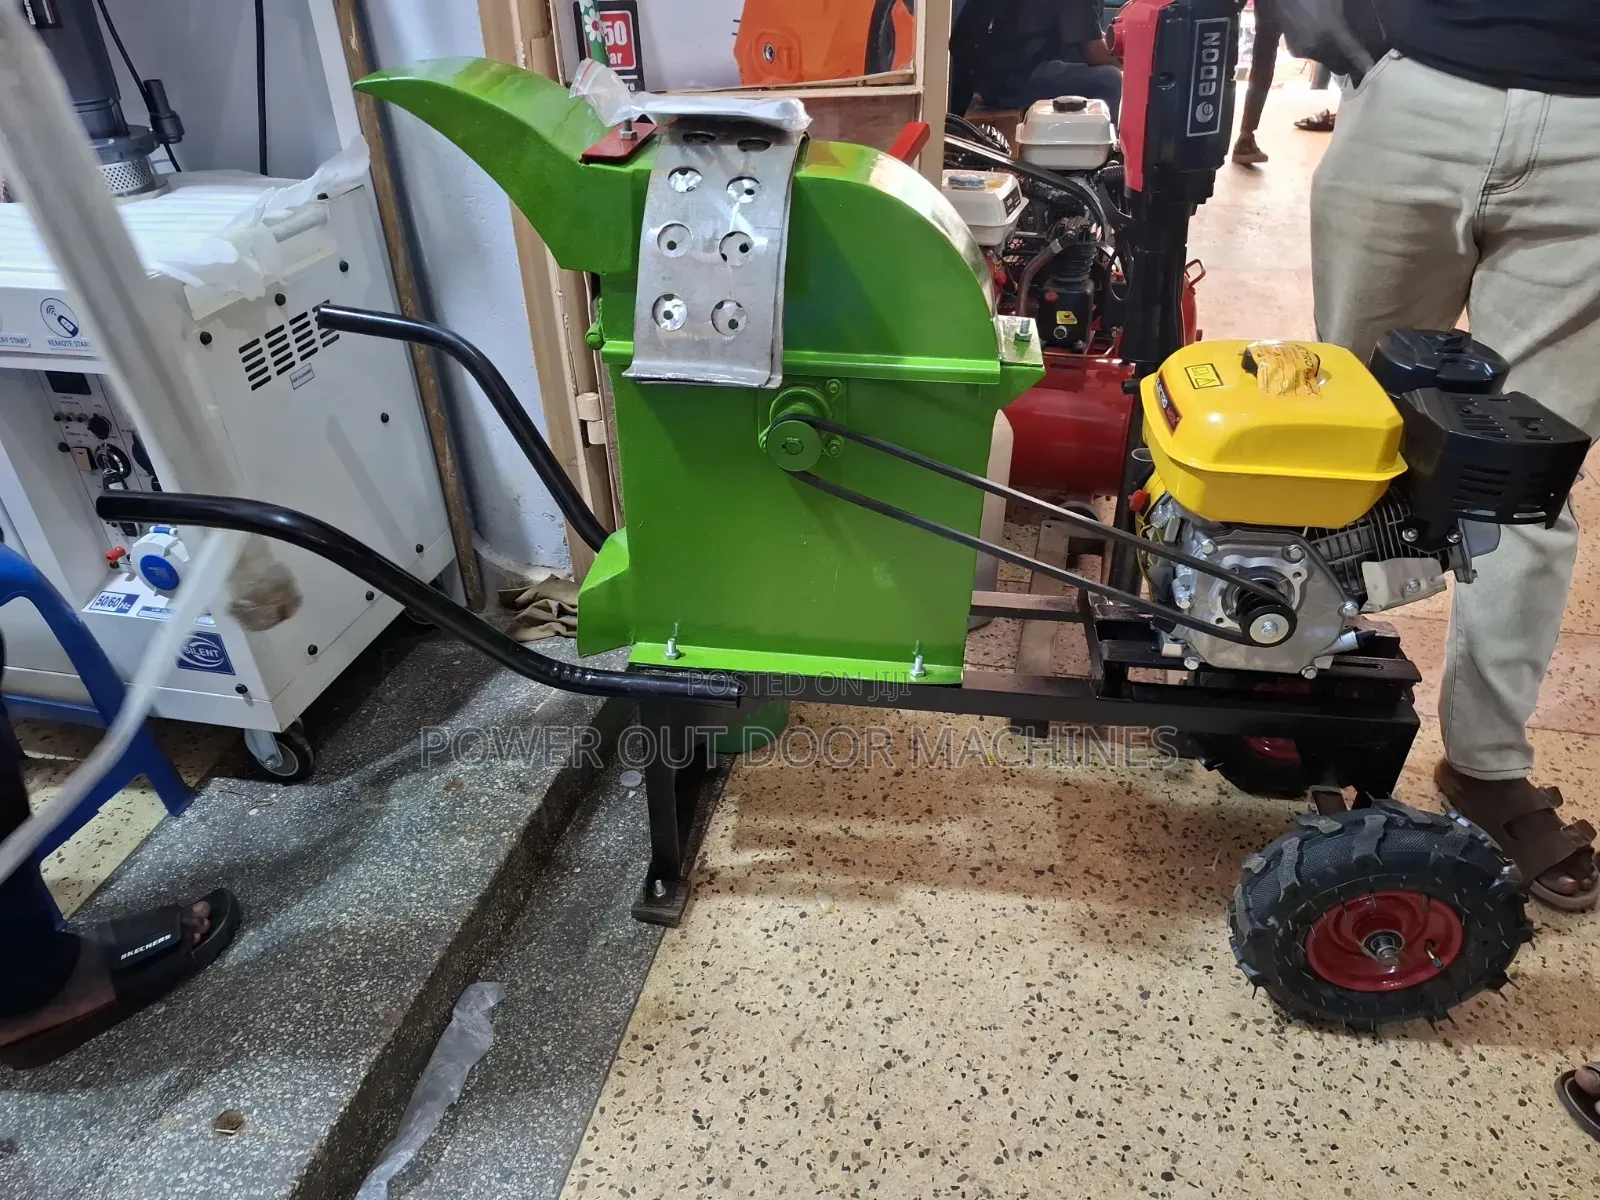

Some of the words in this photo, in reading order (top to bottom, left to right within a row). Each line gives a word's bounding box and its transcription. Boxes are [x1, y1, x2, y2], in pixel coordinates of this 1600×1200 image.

[602, 20, 628, 46] 50
[609, 52, 623, 64] ar
[9, 337, 28, 345] START
[47, 339, 73, 347] REMOTE
[95, 595, 122, 608] 50/60
[118, 601, 132, 610] Hz
[183, 646, 219, 658] SILENT
[120, 933, 172, 961] SKECHERS
